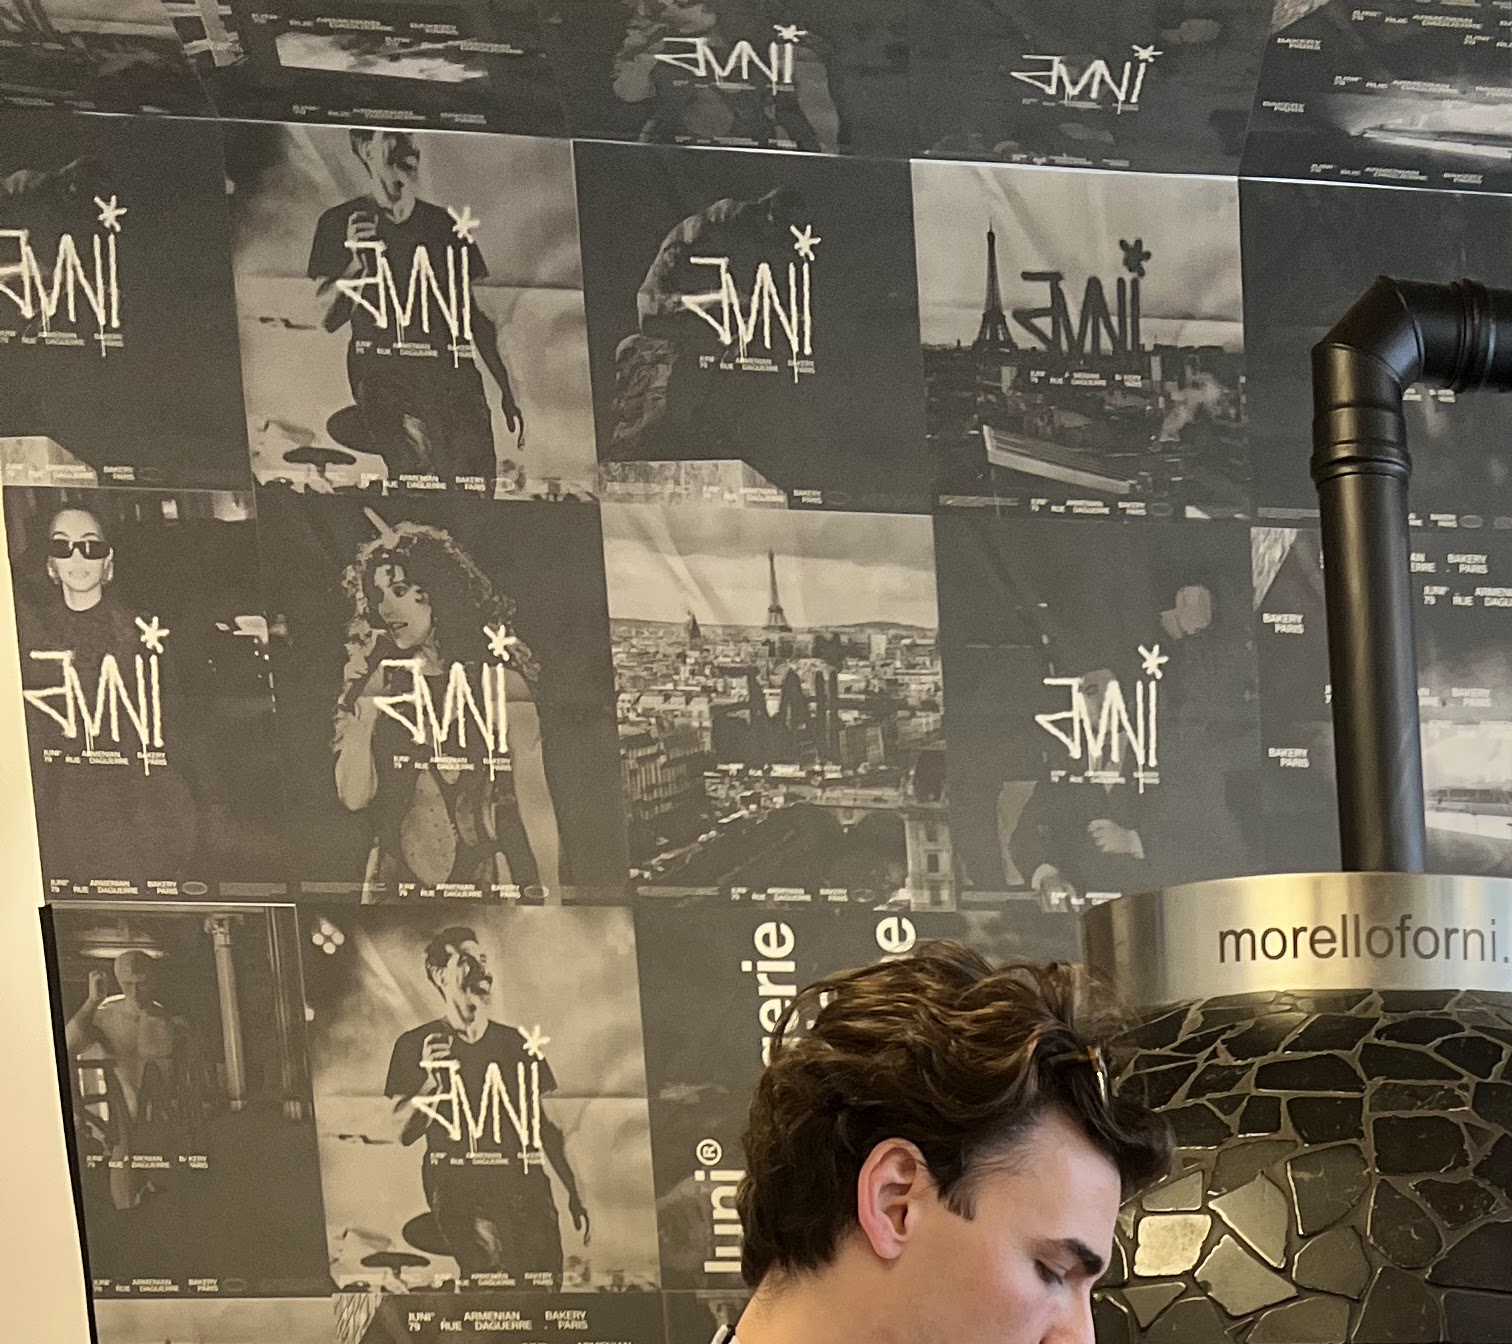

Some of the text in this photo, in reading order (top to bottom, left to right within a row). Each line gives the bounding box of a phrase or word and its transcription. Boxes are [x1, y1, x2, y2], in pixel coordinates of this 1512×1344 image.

[464, 1311, 521, 1321] ARMENIAN
[545, 1310, 587, 1321] BAKERY
[440, 1321, 462, 1331] RUE
[475, 1321, 532, 1331] DAGUERRE
[558, 1321, 588, 1330] PARIS
